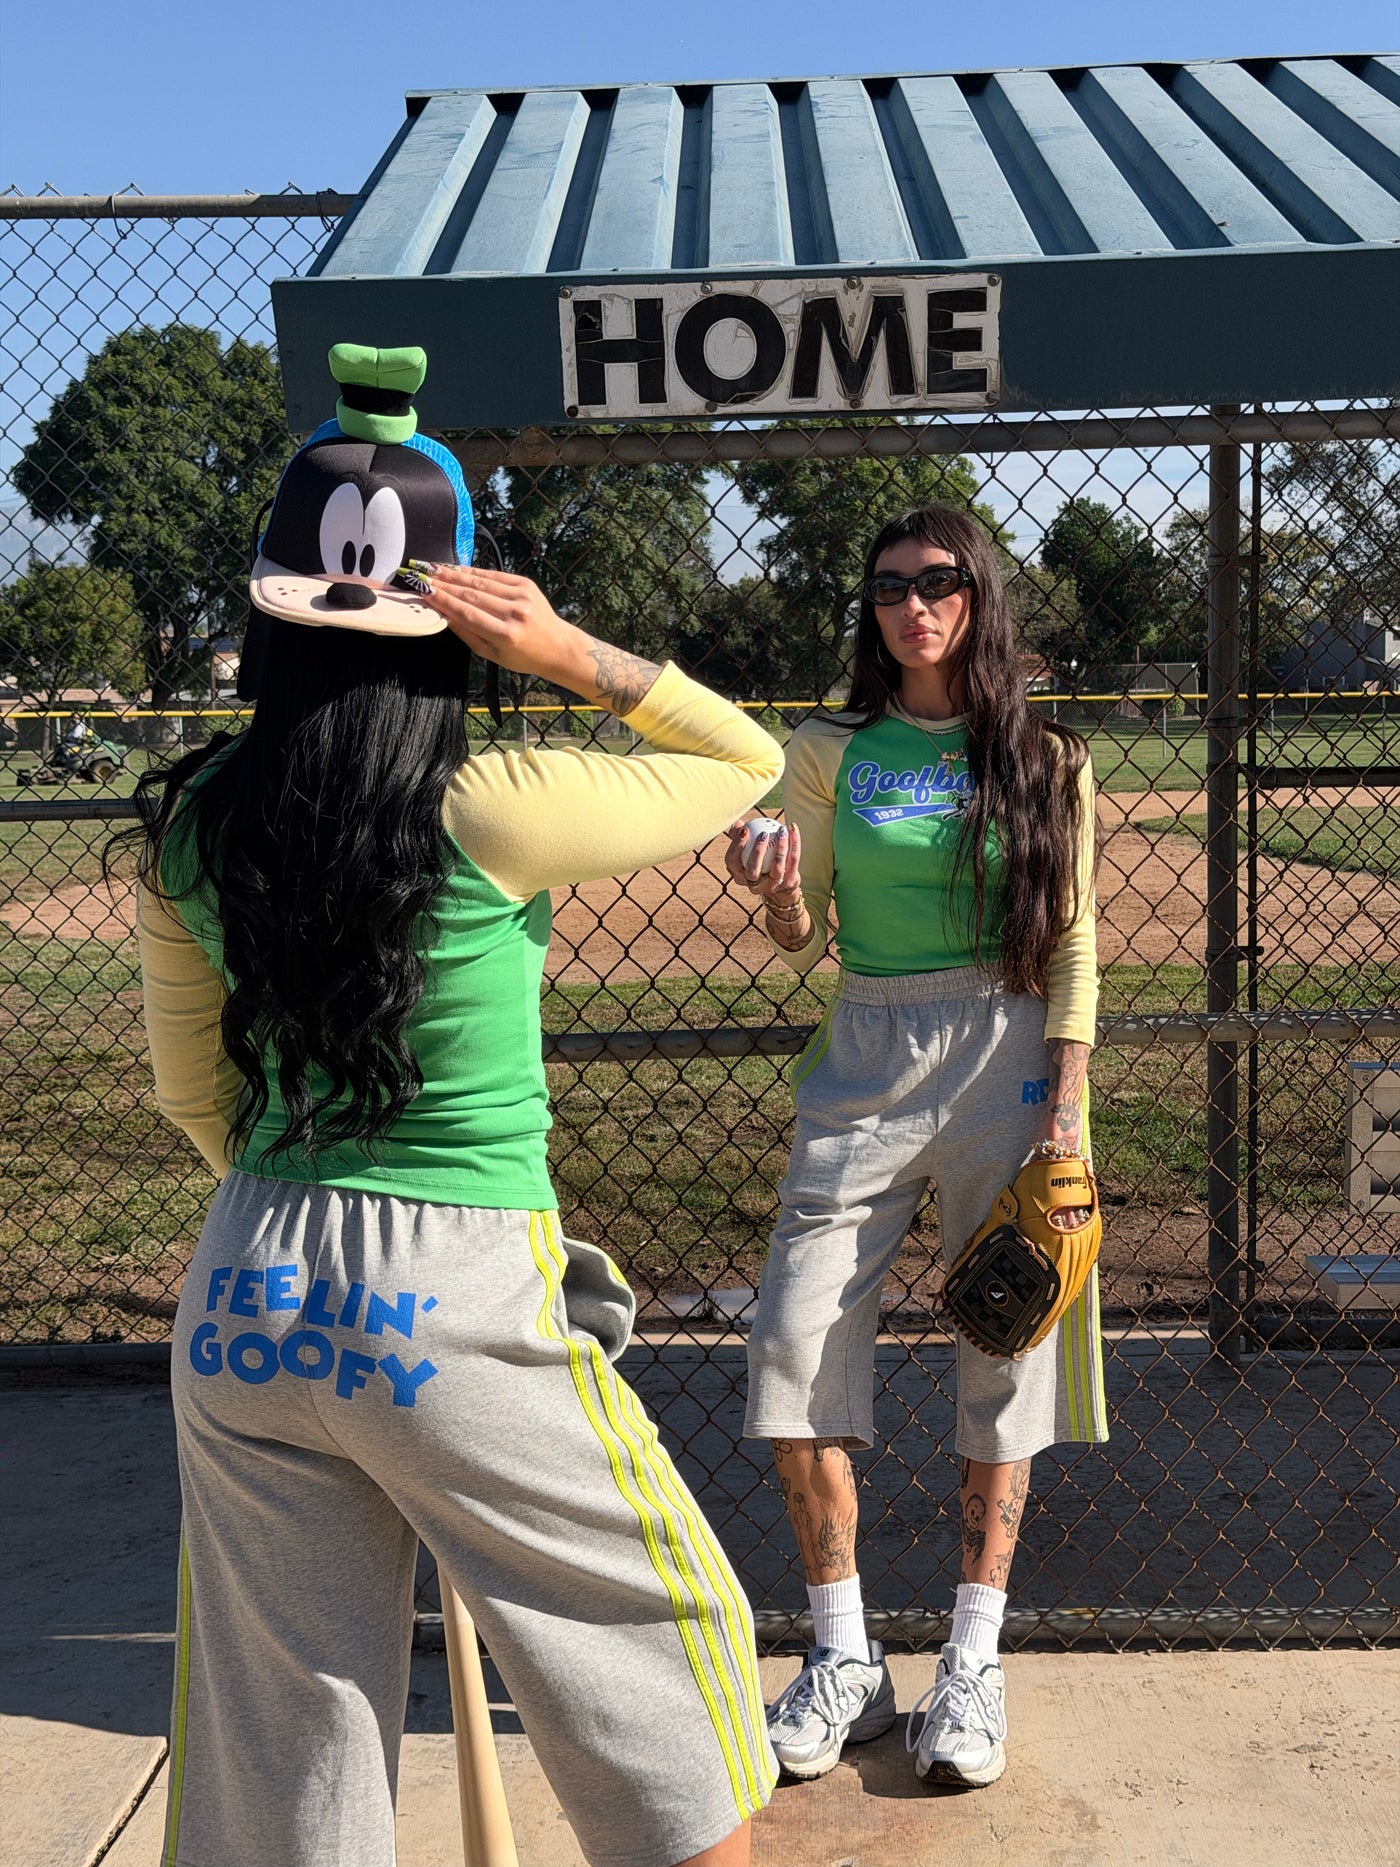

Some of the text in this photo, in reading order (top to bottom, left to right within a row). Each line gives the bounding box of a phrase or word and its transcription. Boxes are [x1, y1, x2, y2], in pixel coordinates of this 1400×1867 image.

[573, 287, 988, 404] HOME
[848, 761, 975, 805] Goofba
[874, 808, 903, 820] 1932
[206, 1264, 439, 1340] FEELIN'
[189, 1321, 439, 1409] GOOFY
